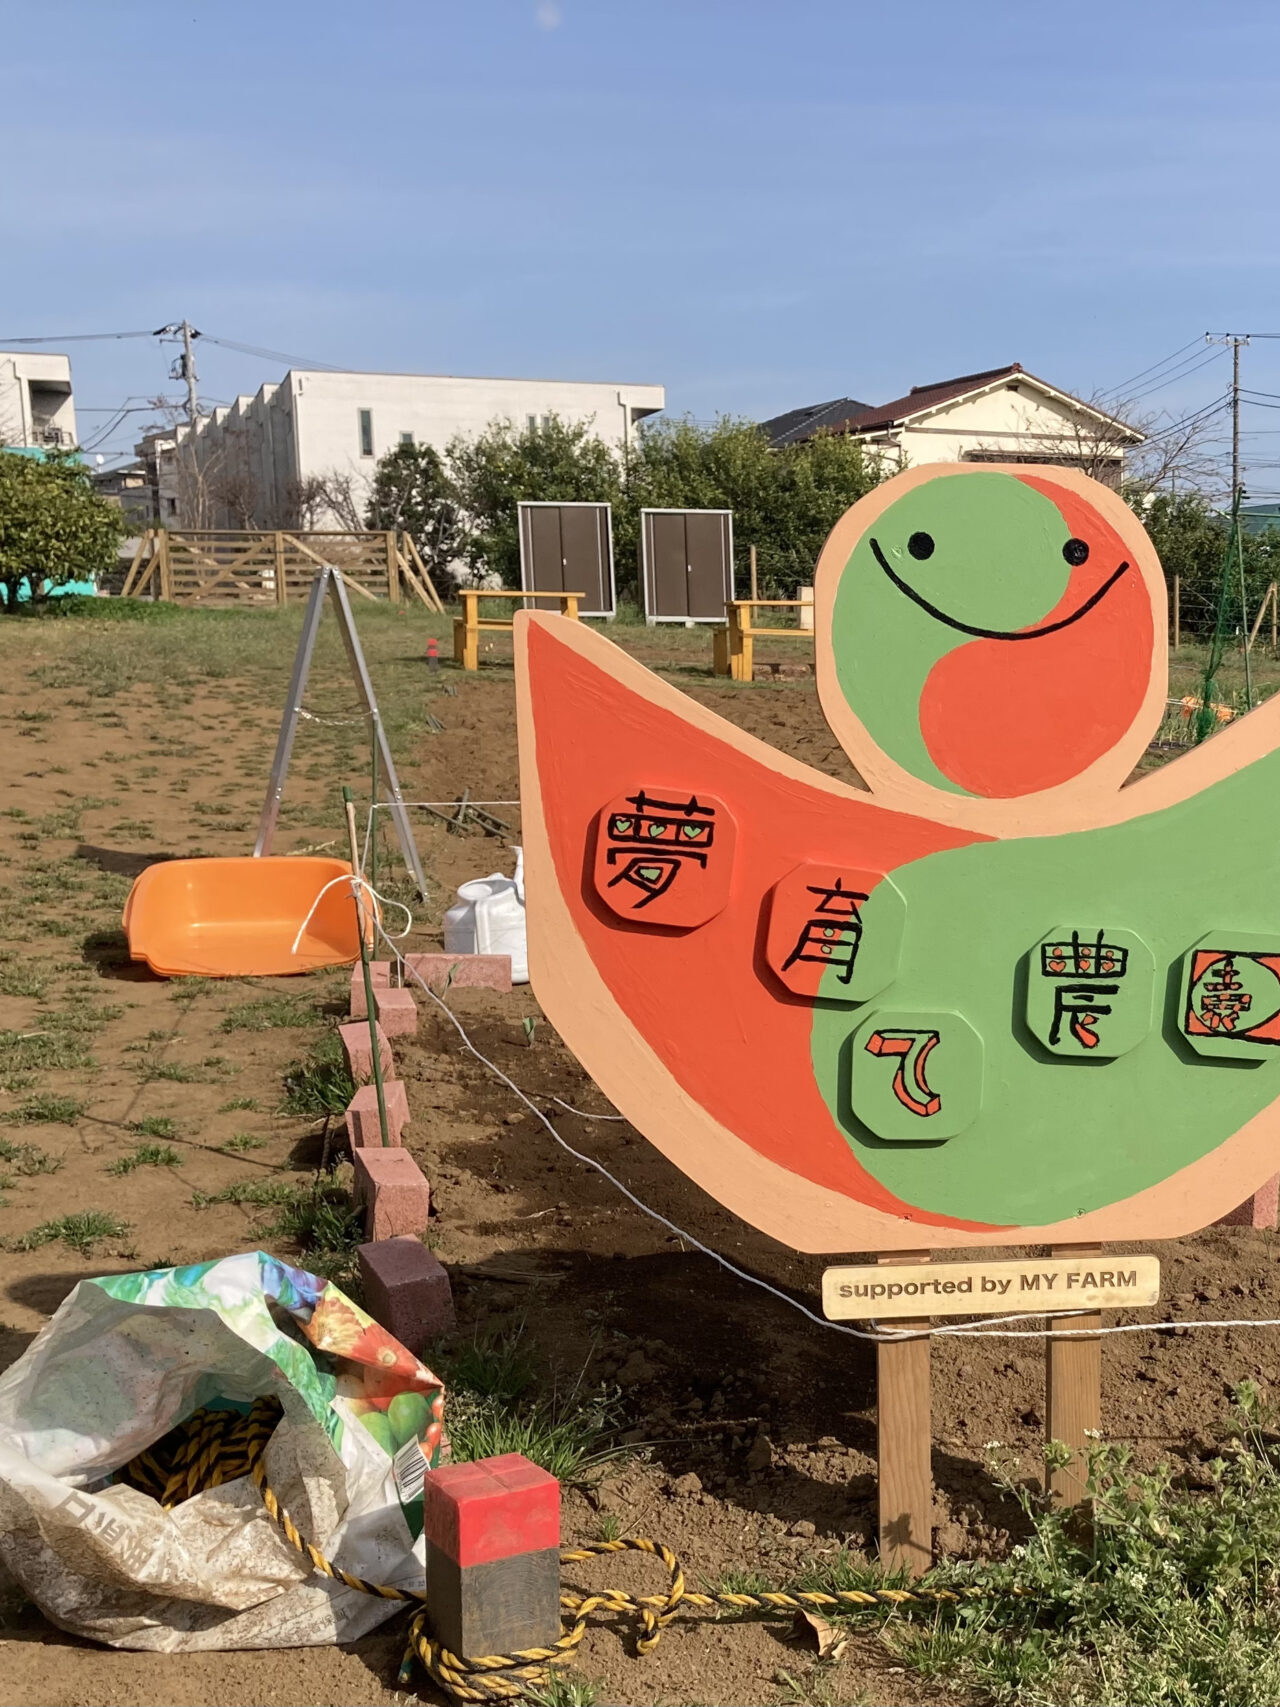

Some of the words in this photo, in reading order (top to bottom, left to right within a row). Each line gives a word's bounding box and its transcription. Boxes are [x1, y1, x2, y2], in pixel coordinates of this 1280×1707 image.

[839, 1276, 973, 1300] supported
[980, 1275, 1012, 1296] by
[1019, 1273, 1058, 1292] MY
[1066, 1270, 1137, 1290] FARM
